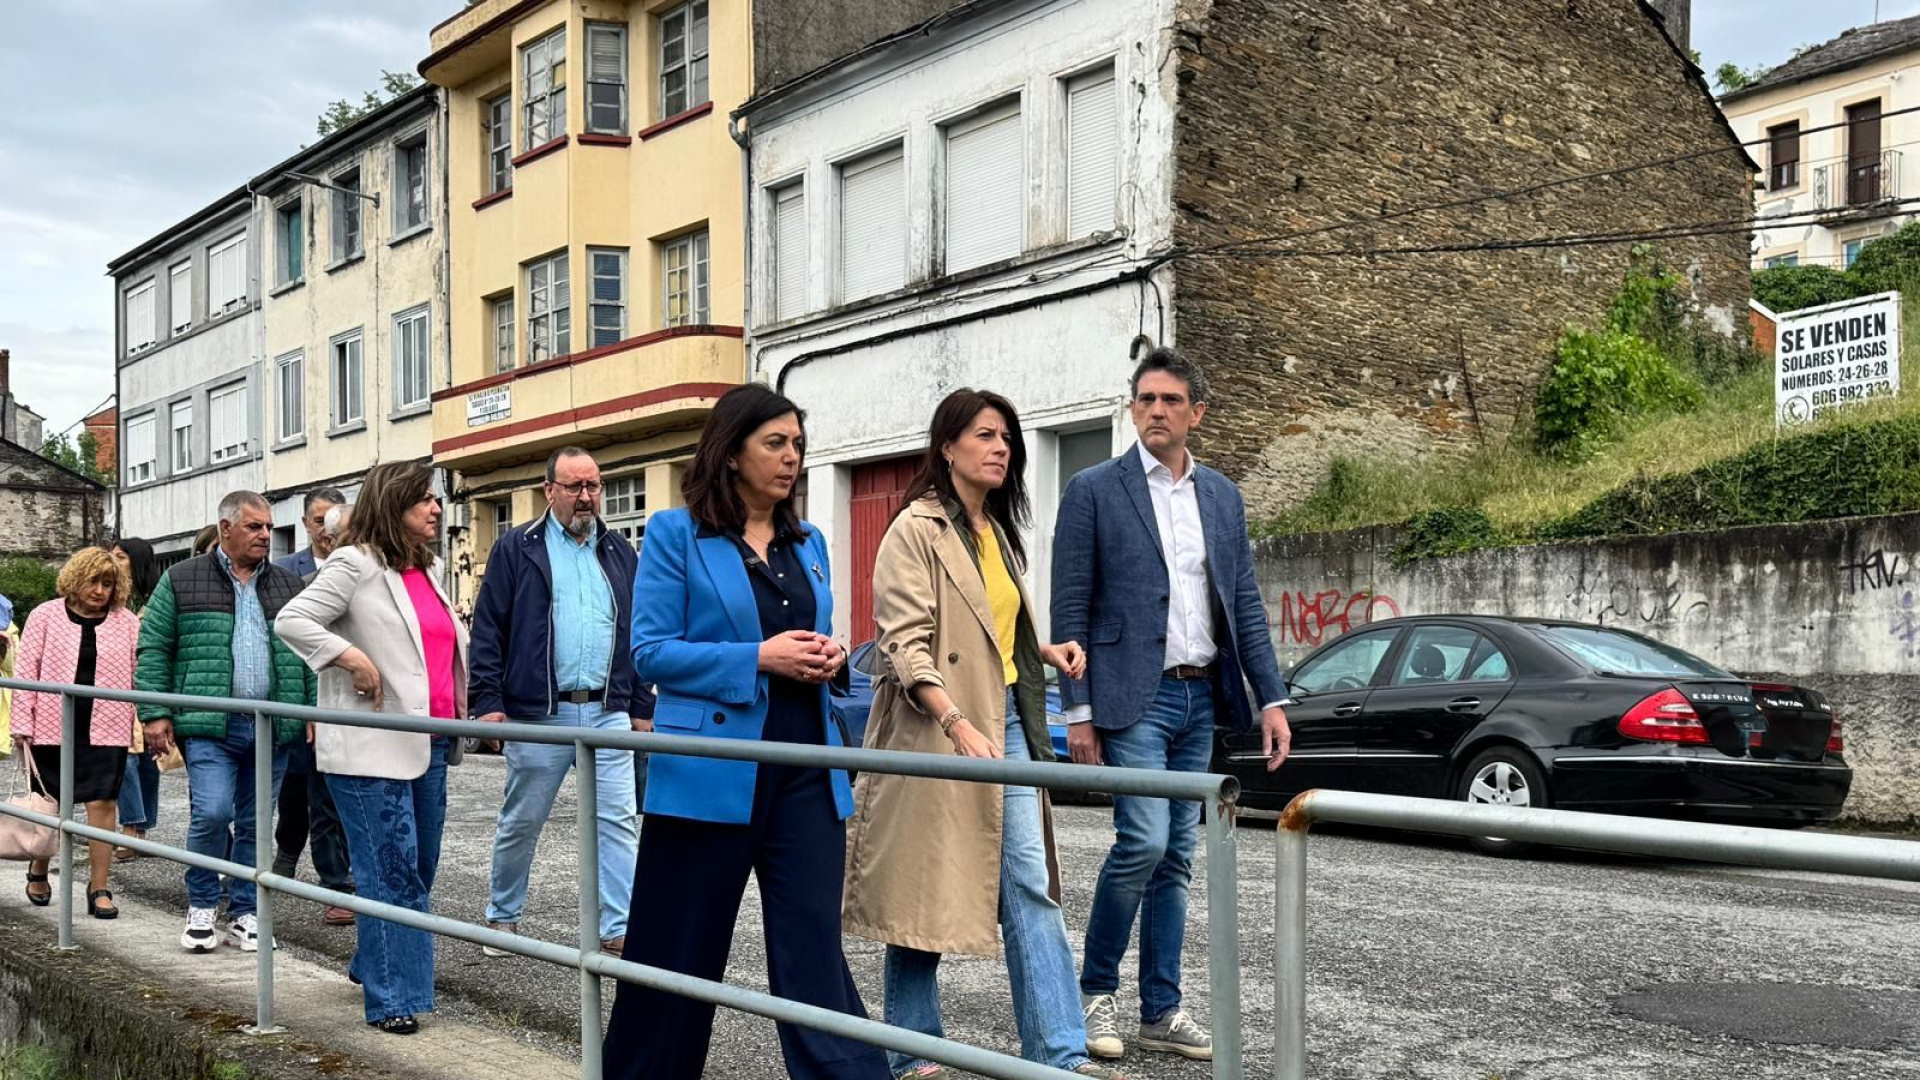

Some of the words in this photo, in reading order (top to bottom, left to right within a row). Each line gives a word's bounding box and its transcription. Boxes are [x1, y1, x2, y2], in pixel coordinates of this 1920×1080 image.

[1781, 328, 1805, 353] SE
[1810, 312, 1886, 348] VENDEN
[1782, 350, 1835, 373] SOLARES
[1837, 347, 1844, 363] Y
[1847, 341, 1887, 361] CASAS
[1782, 370, 1836, 391] NÚMEROS:
[1838, 360, 1888, 382] 24-26-28
[1812, 388, 1837, 406] 606
[1840, 384, 1863, 401] 982
